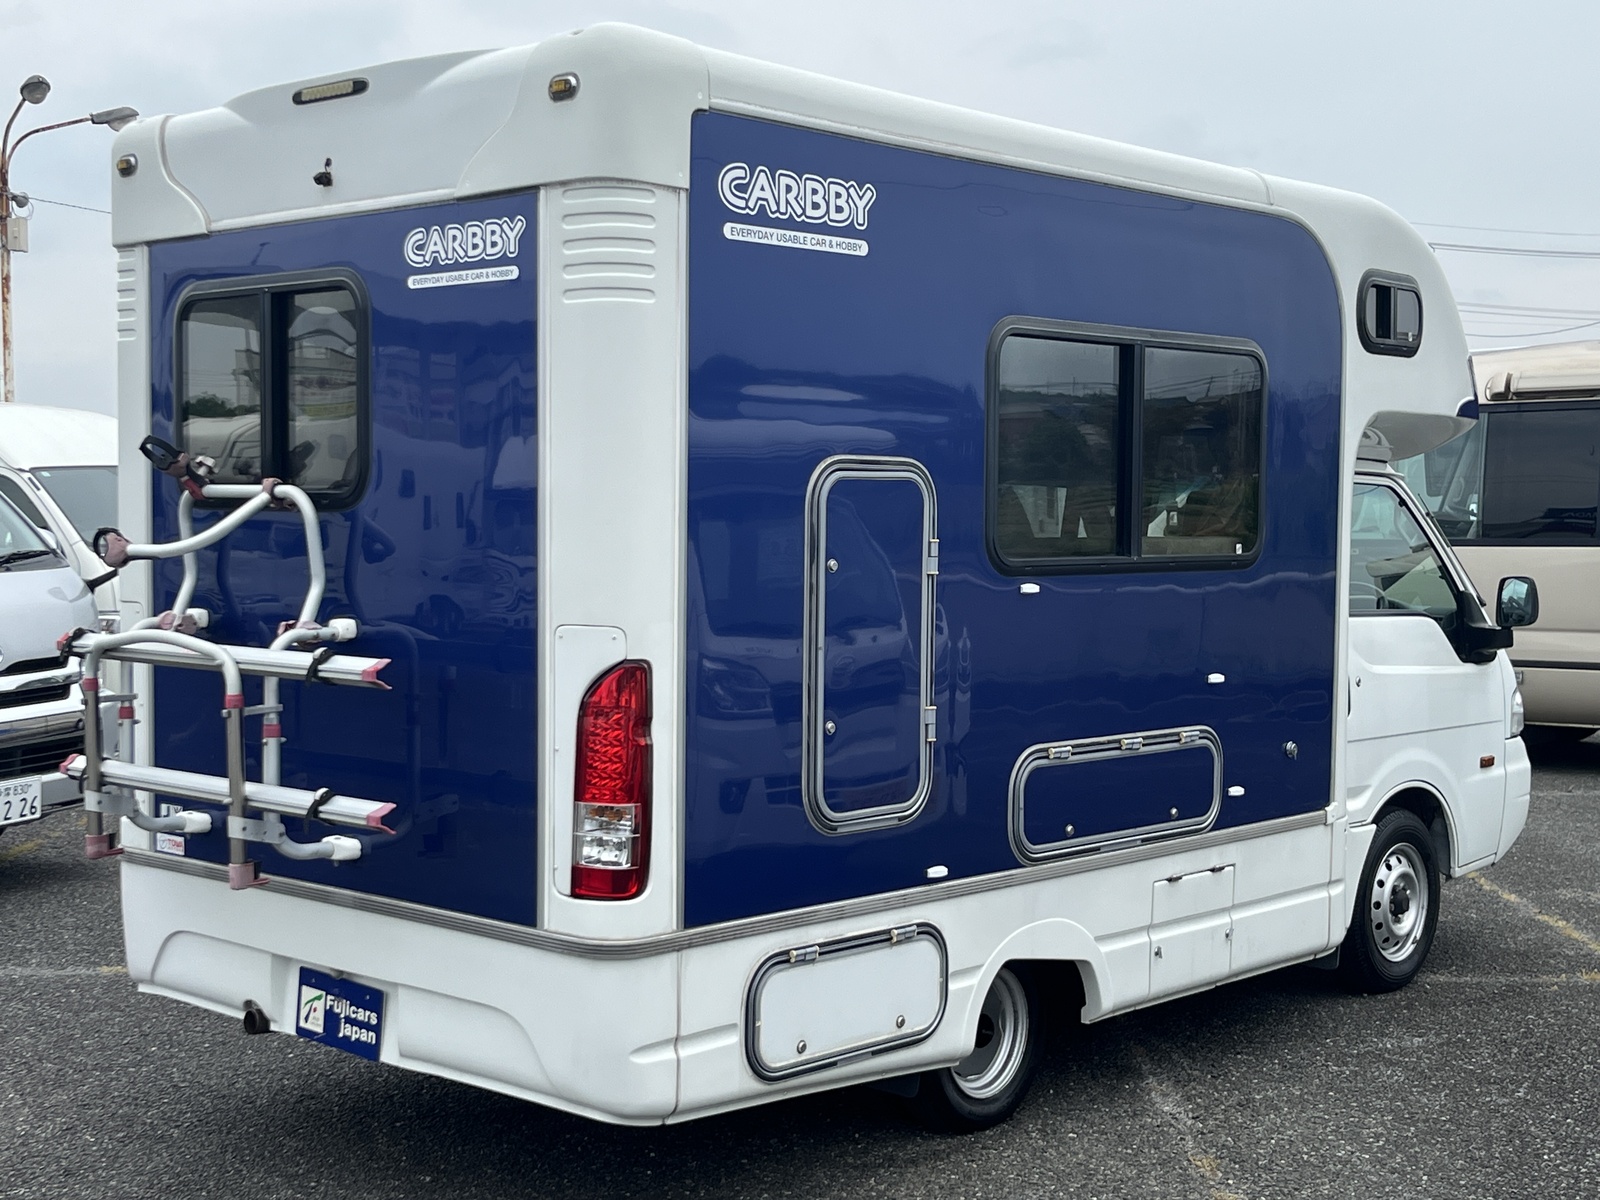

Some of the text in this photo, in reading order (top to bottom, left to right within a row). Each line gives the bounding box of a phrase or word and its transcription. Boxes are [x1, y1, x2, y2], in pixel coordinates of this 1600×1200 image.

[718, 162, 876, 230] CARBBY
[404, 215, 526, 267] CARBBY
[730, 227, 863, 252] EVERYDAY USABLE CAR & HOBBY
[412, 269, 515, 286] EVERYDAY USABLE CAR & HOBBY
[326, 994, 378, 1025] Fujicars
